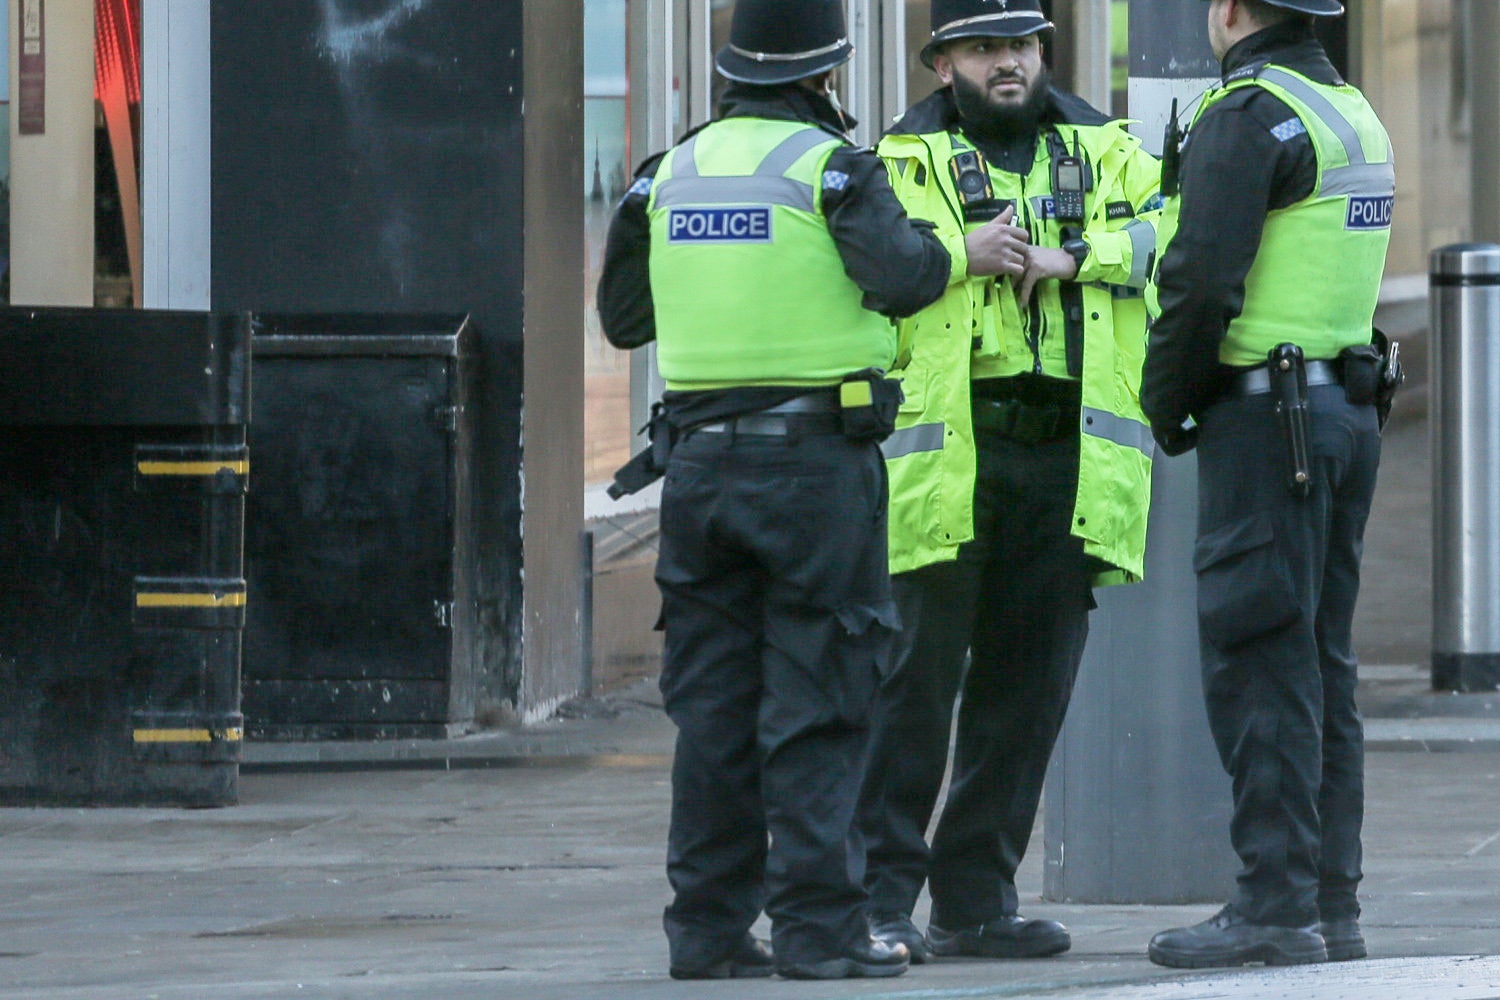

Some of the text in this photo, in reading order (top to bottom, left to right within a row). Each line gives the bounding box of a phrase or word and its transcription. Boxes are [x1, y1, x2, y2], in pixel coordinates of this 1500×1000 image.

[1108, 205, 1126, 216] KHAN
[1350, 199, 1394, 223] POLIC
[671, 212, 767, 237] POLICE
